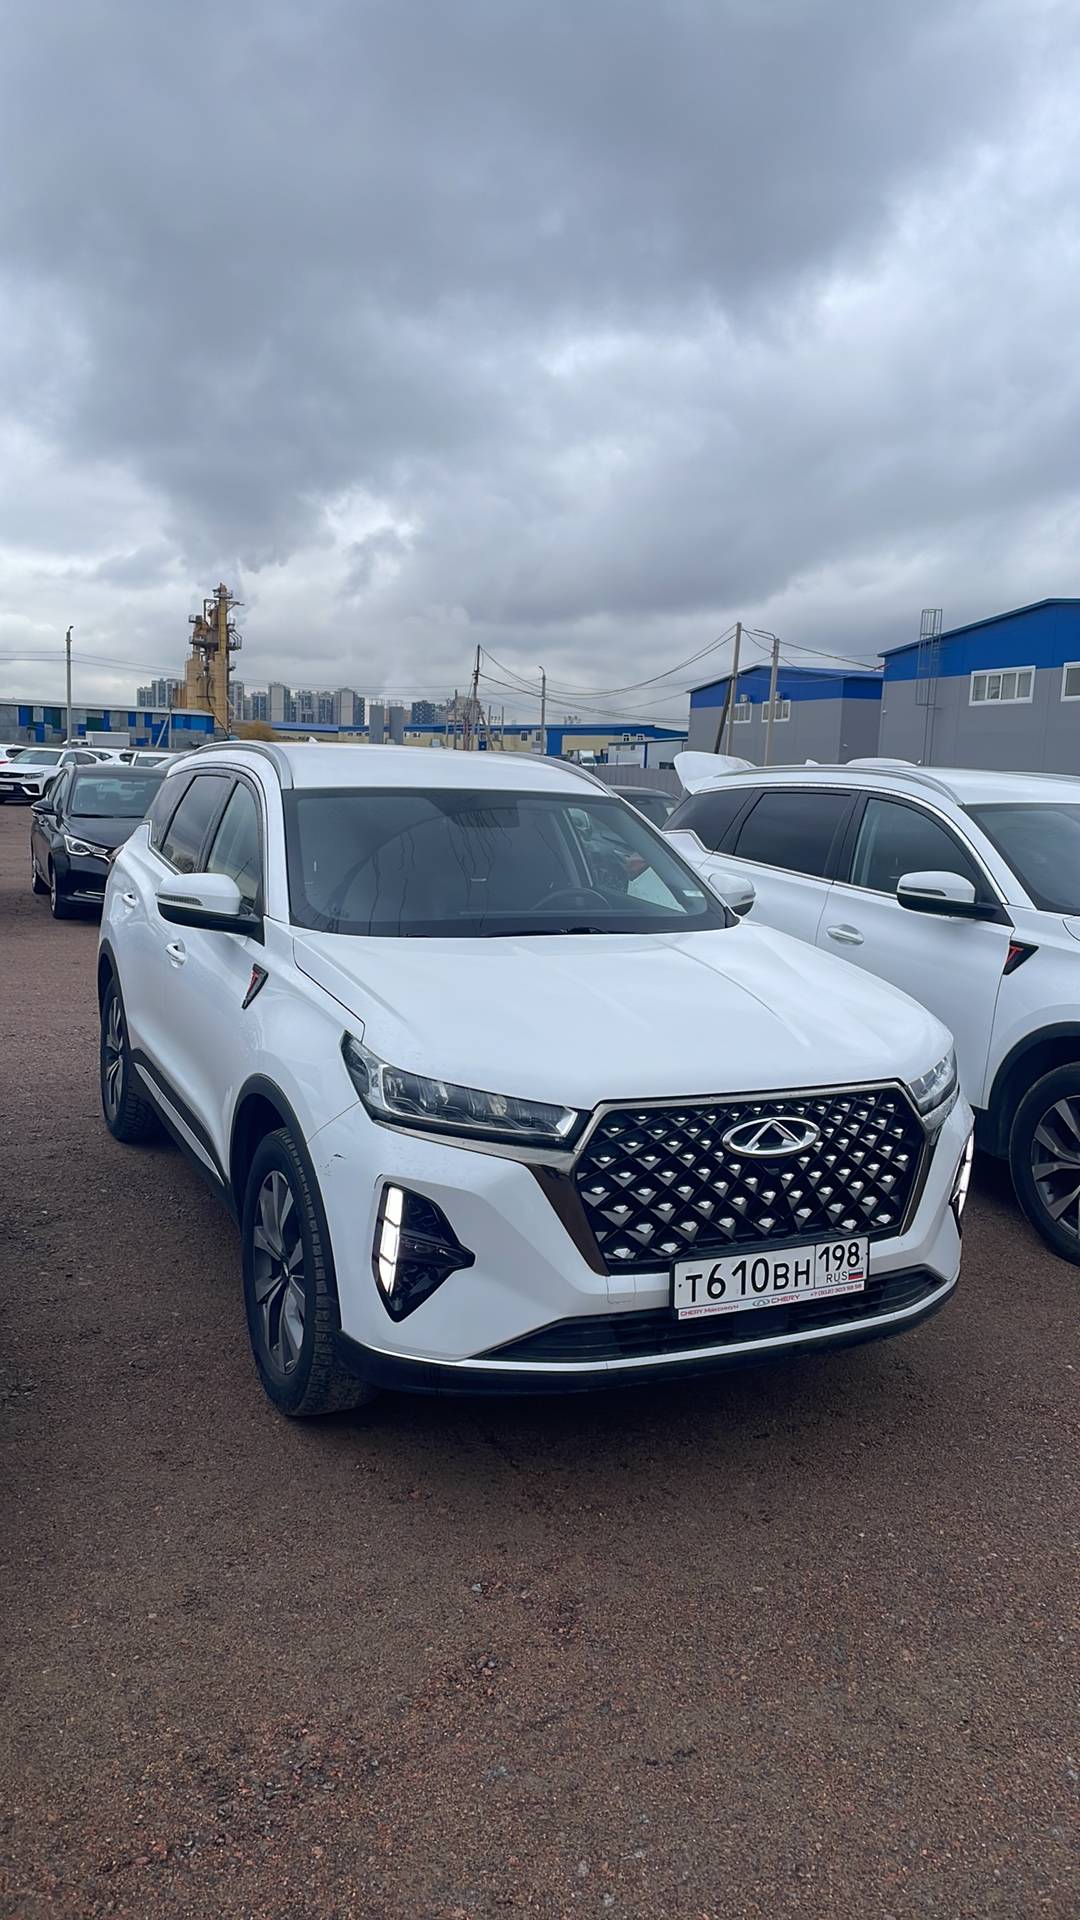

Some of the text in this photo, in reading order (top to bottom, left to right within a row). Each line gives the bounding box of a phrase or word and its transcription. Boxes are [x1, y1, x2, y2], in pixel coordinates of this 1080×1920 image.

[818, 1241, 860, 1273] 198
[826, 1271, 848, 1284] RUS
[771, 1294, 800, 1304] CHERY
